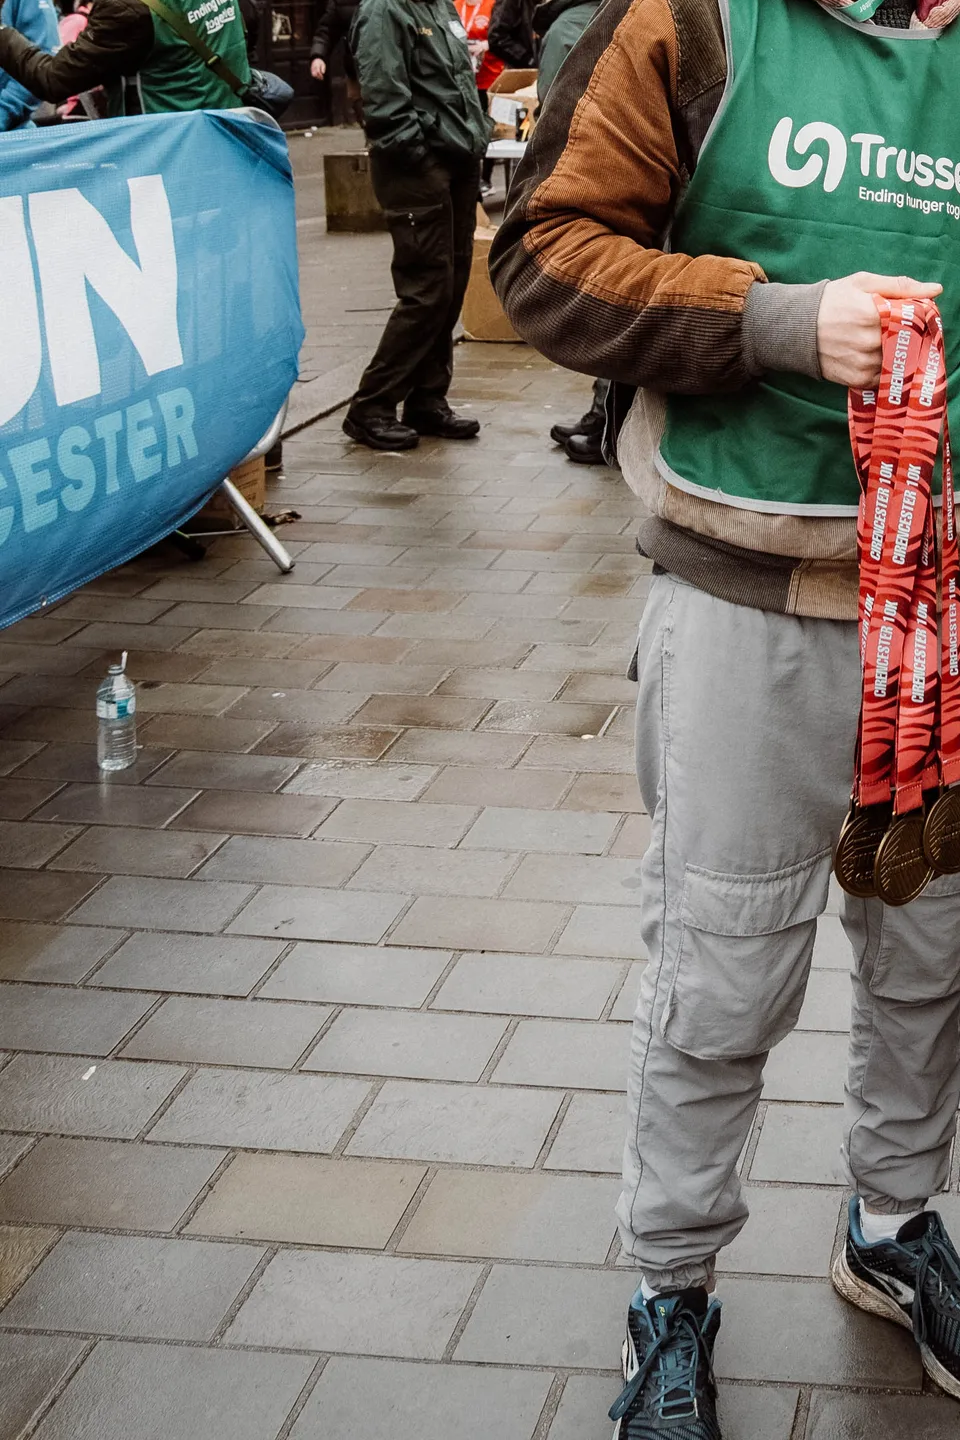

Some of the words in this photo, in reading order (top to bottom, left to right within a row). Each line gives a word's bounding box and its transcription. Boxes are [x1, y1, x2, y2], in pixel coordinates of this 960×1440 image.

[187, 0, 219, 25] Ending
[859, 186, 904, 208] Ending
[906, 192, 944, 215] hunger
[888, 329, 911, 406] CIRENCESTER
[901, 304, 915, 326] 10K
[879, 461, 894, 485] 10K
[870, 487, 890, 561] CIRENCESTER
[892, 489, 917, 565] CIRENCESTER
[906, 463, 921, 488] 10K
[864, 593, 875, 618] 10K
[883, 599, 899, 623] 10K
[917, 601, 928, 626] 10K
[874, 625, 894, 698] CIRENCESTER
[911, 627, 927, 703] CIRENCESTER
[949, 603, 959, 677] CIRENCESTER
